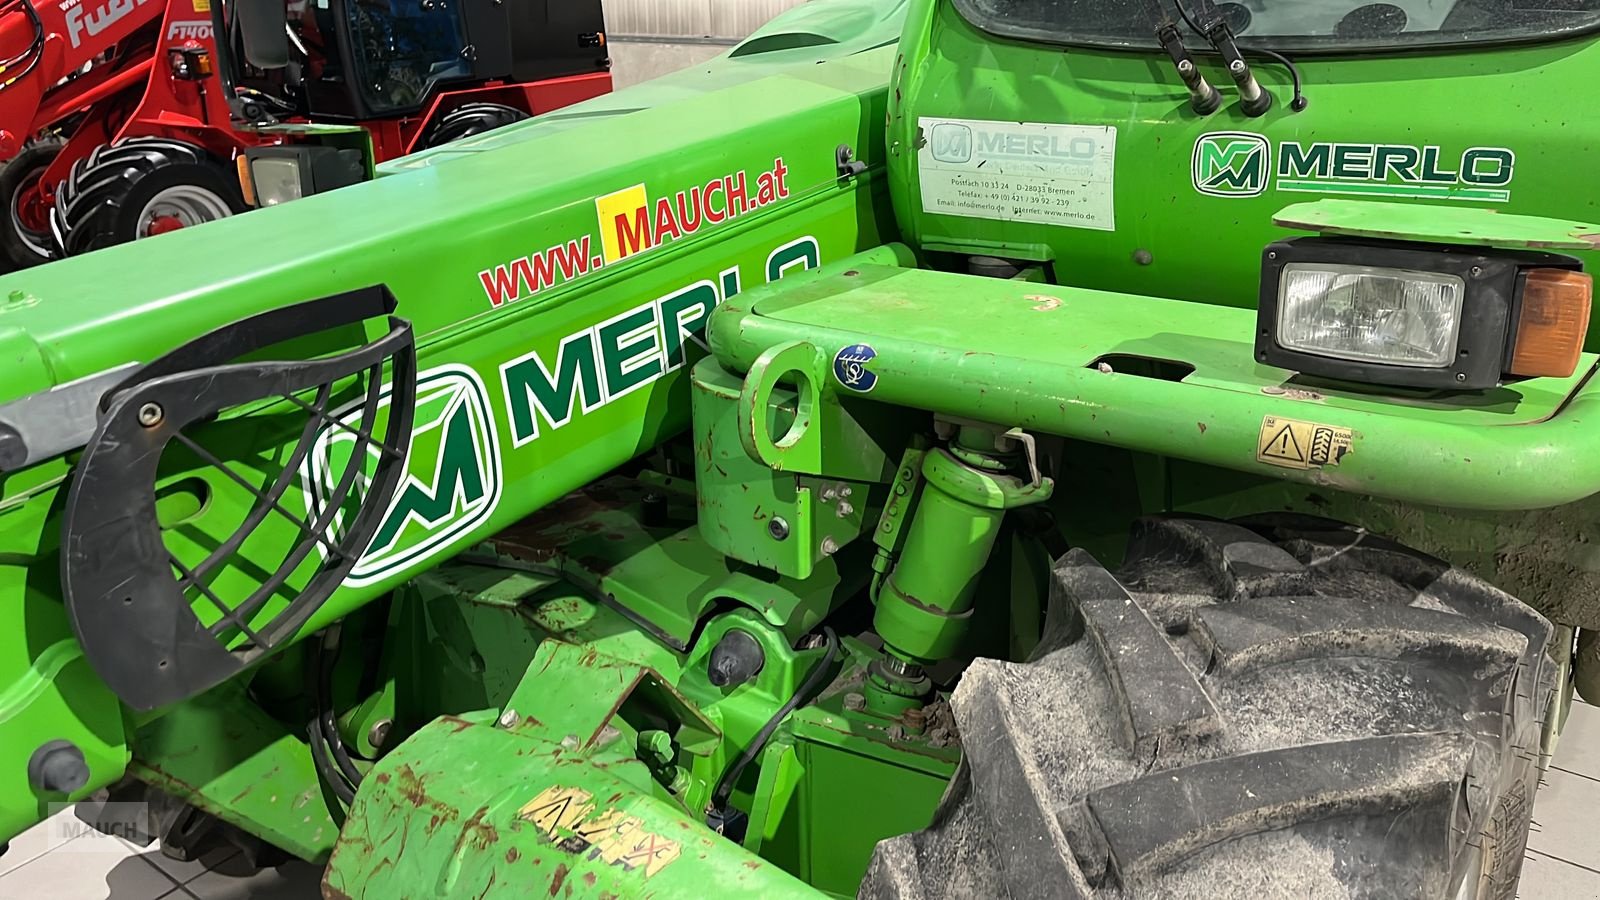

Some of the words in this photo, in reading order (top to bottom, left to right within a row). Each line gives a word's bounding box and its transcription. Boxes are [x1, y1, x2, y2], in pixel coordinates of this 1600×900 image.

[977, 132, 1095, 158] MERLO
[1277, 142, 1515, 187] MERLO
[951, 178, 979, 188] Postfach
[1001, 182, 1009, 190] 24
[1016, 183, 1046, 193] D-28033
[1047, 187, 1076, 196] Bremen
[1031, 196, 1040, 204] 39
[1041, 197, 1050, 205] 92
[1056, 198, 1070, 206] 239
[478, 157, 790, 309] www.MAUCH.at
